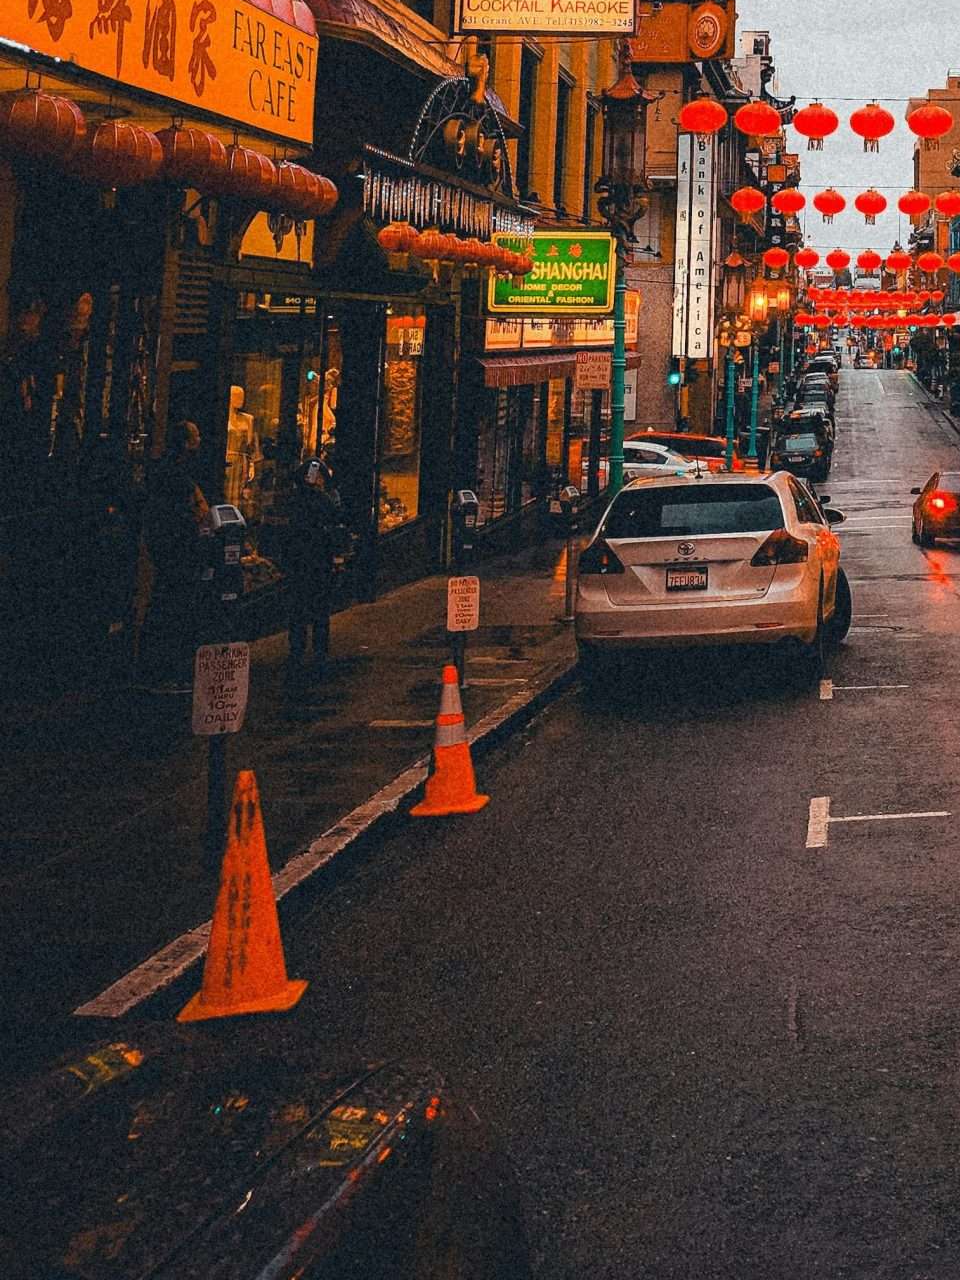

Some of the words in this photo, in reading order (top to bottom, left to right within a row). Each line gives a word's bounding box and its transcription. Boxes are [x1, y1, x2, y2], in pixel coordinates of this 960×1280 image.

[462, 15, 477, 24] 631
[232, 9, 268, 66] FAR
[273, 29, 315, 82] EAST
[248, 69, 297, 123] CAFÉ
[697, 140, 706, 196] Bank
[697, 209, 705, 236] of
[531, 261, 608, 281] SHANGHAI
[551, 283, 583, 291] DECOR
[508, 295, 551, 304] ORIENTAL
[556, 296, 594, 304] FASHION
[694, 251, 705, 350] America
[204, 711, 240, 724] DAILY
